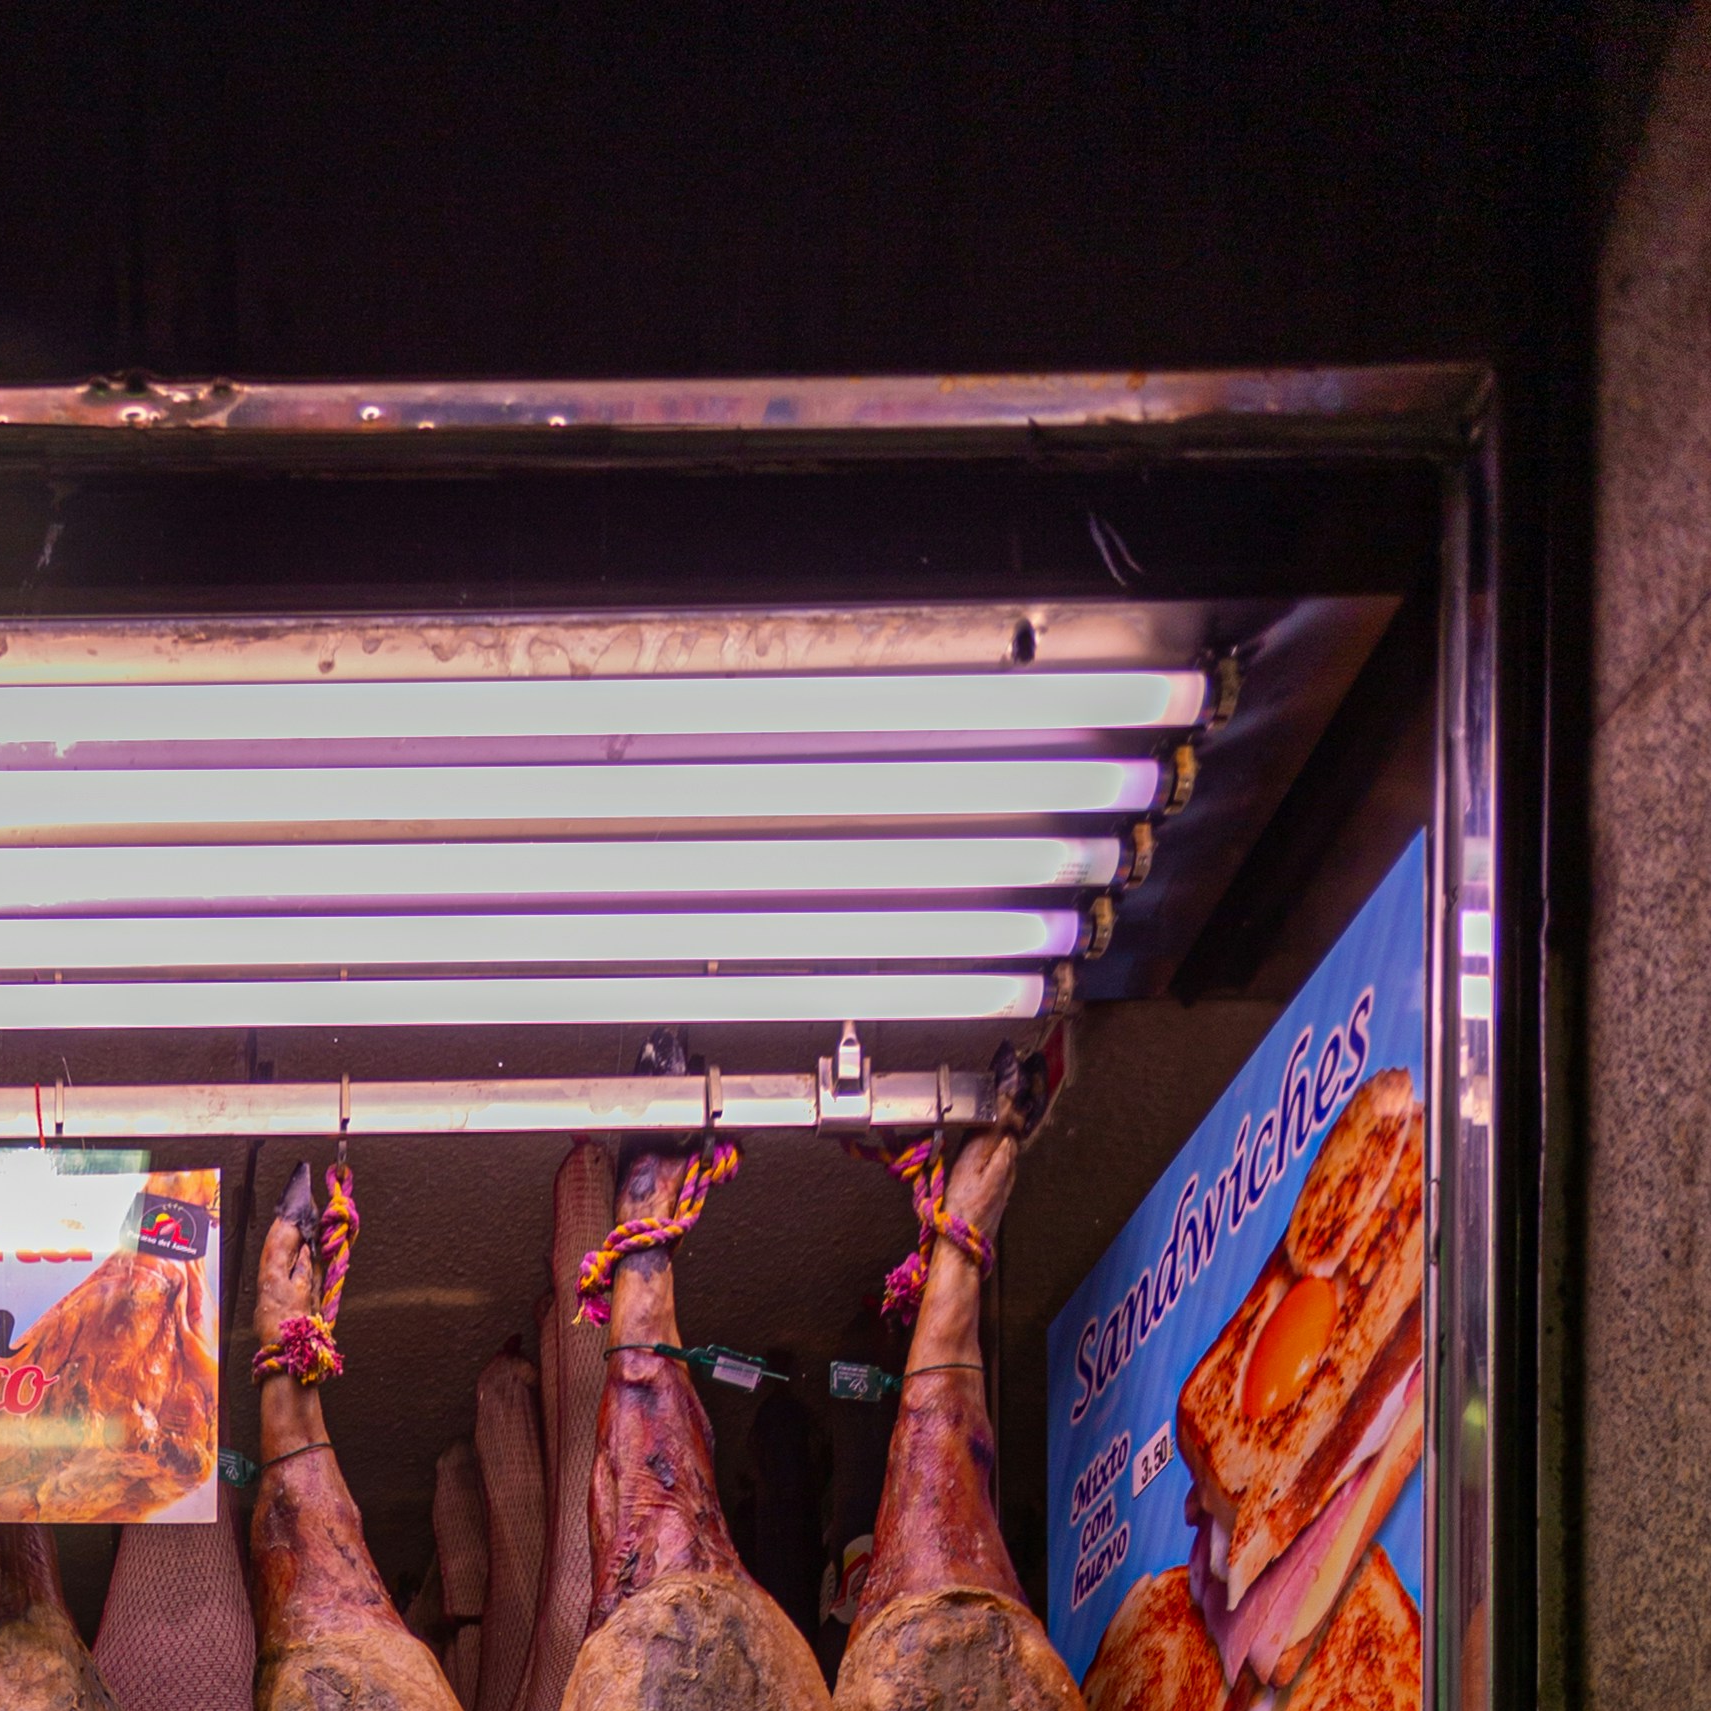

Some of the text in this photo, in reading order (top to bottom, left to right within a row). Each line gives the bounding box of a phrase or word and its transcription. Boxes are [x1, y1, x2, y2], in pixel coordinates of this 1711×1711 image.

[1072, 992, 1373, 1420] Sandwiches
[1072, 1438, 1129, 1519] Mixto
[1081, 1499, 1116, 1549] con
[1072, 1526, 1129, 1608] huevo
